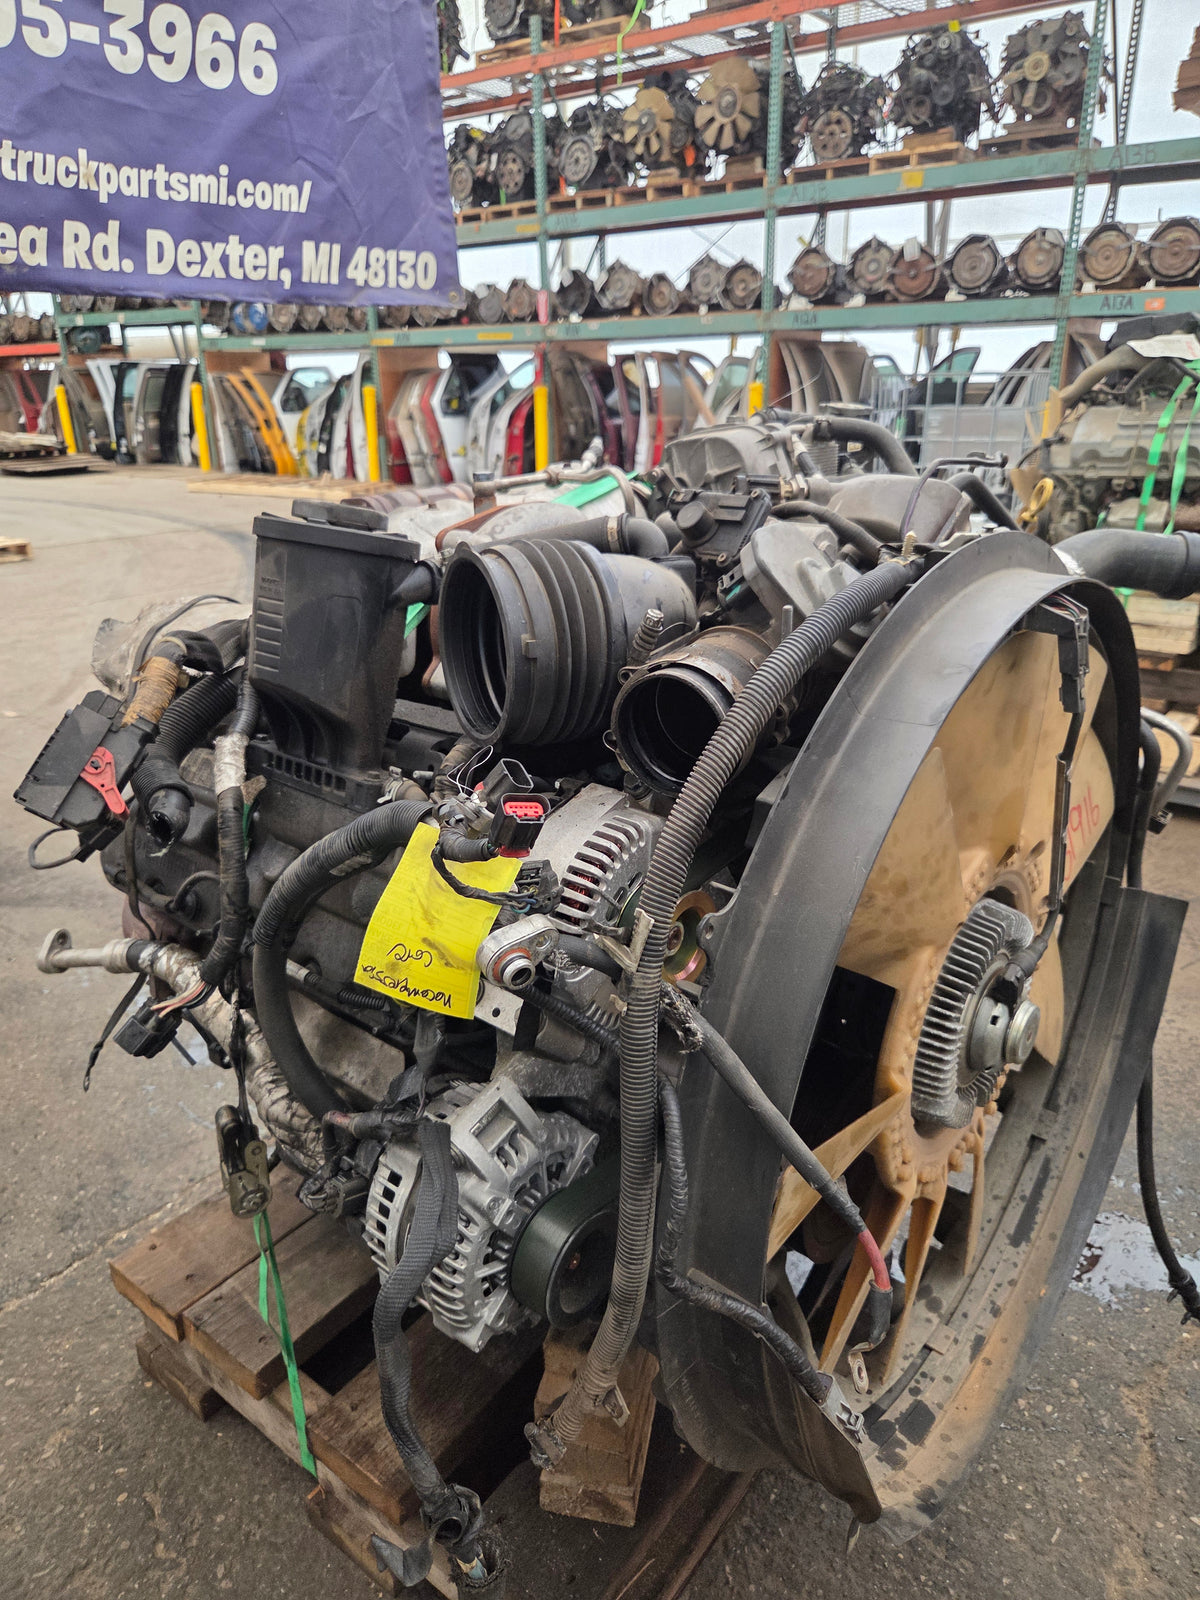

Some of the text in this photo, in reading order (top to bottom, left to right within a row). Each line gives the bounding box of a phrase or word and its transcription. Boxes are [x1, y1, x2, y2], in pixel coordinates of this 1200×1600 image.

[0, 140, 313, 213] truckpartsmi.com/
[62, 219, 135, 273] Rd.
[145, 228, 292, 290] Dexter,
[301, 239, 342, 285] MI
[346, 245, 438, 291] 48130
